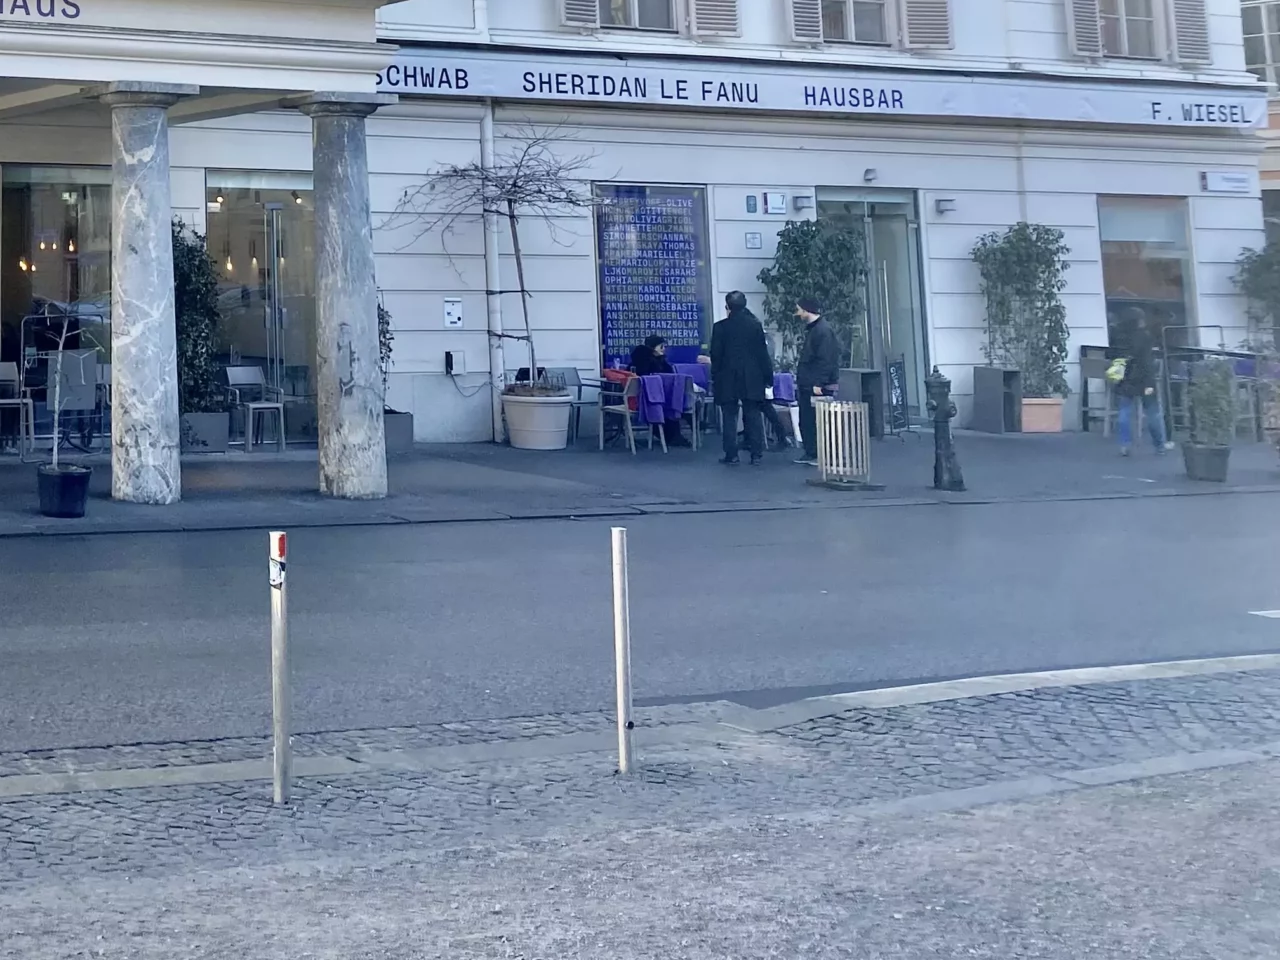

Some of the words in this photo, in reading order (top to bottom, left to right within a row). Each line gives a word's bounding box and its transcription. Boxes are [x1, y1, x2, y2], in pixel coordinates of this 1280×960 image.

[522, 71, 648, 98] SHERIDAN
[660, 78, 689, 101] LE
[701, 80, 759, 104] FANU
[804, 85, 904, 109] HAUSBAR
[1151, 102, 1172, 120] F.
[1181, 103, 1252, 124] WIESEL
